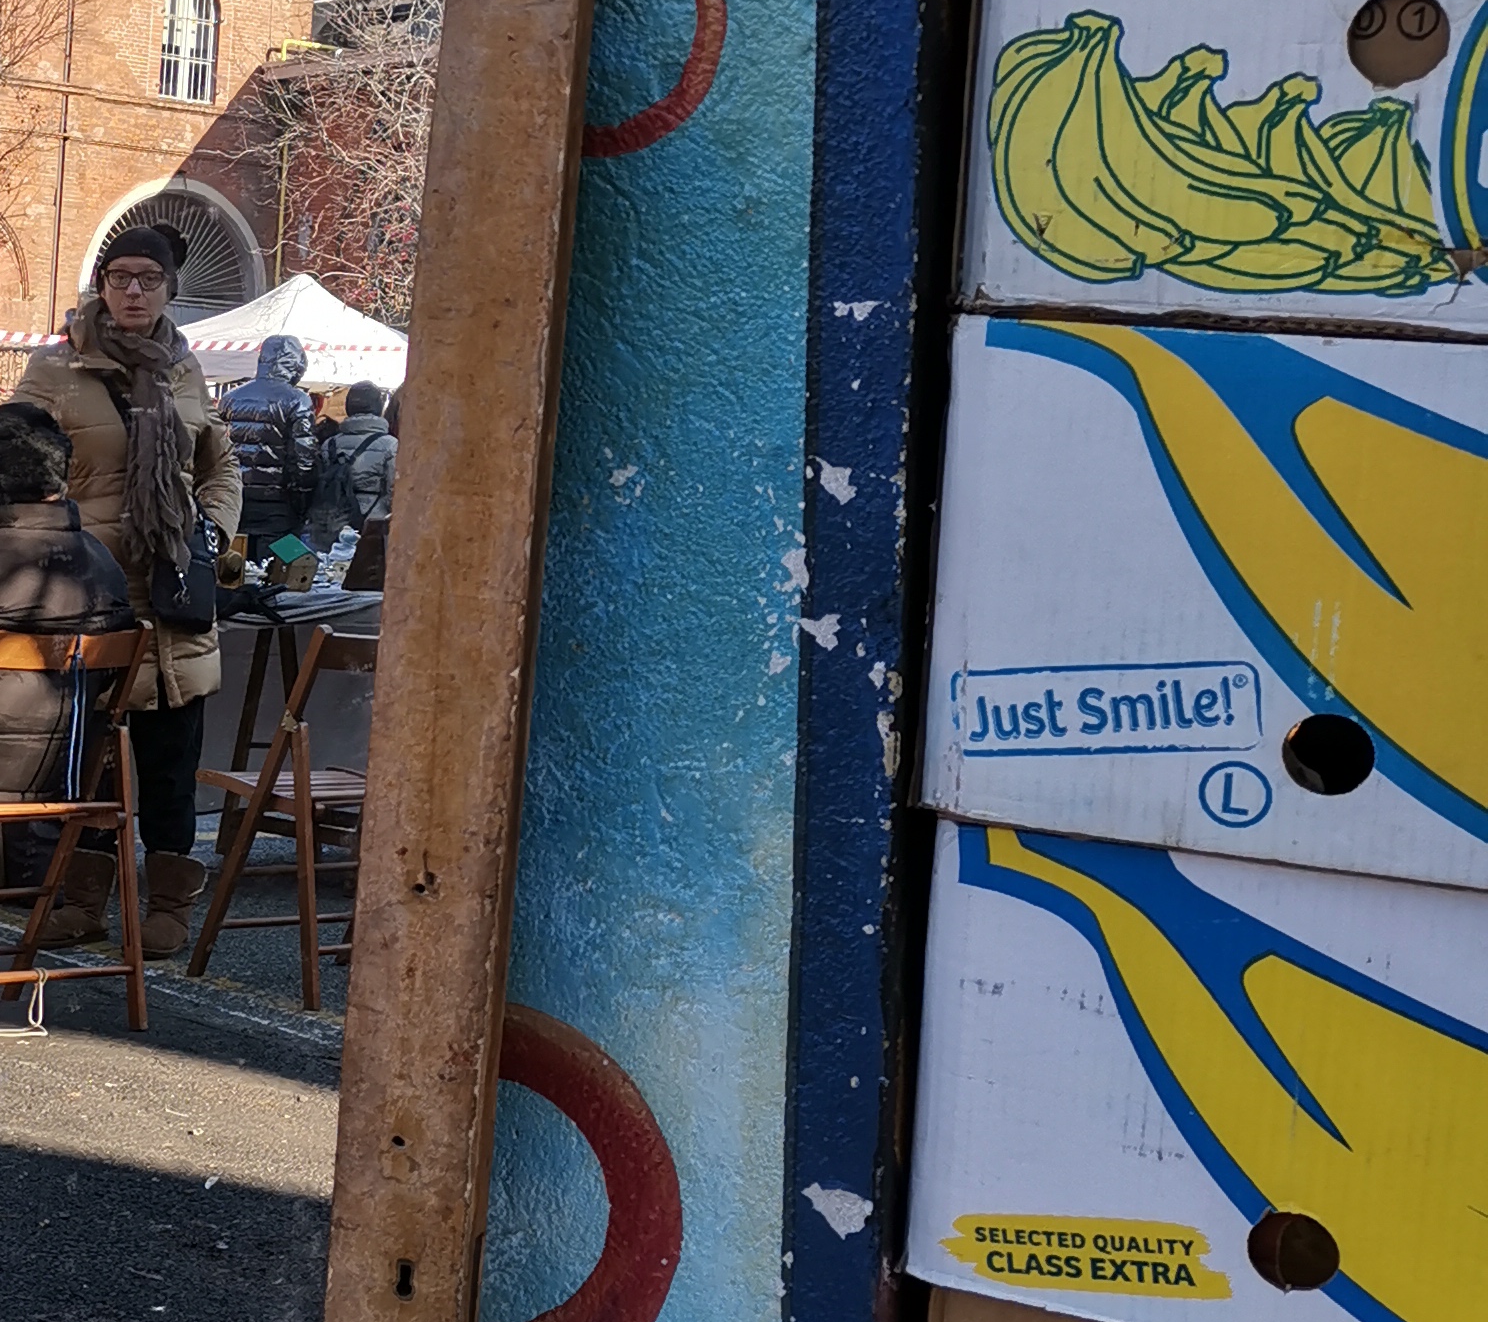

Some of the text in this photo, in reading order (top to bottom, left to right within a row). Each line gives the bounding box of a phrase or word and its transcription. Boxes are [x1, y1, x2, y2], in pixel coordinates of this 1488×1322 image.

[968, 676, 1235, 742] Just Smile!
[1221, 772, 1250, 816] L
[974, 1226, 1195, 1257] SELECTED QUALITY
[986, 1250, 1198, 1287] CLASS EXTRA
